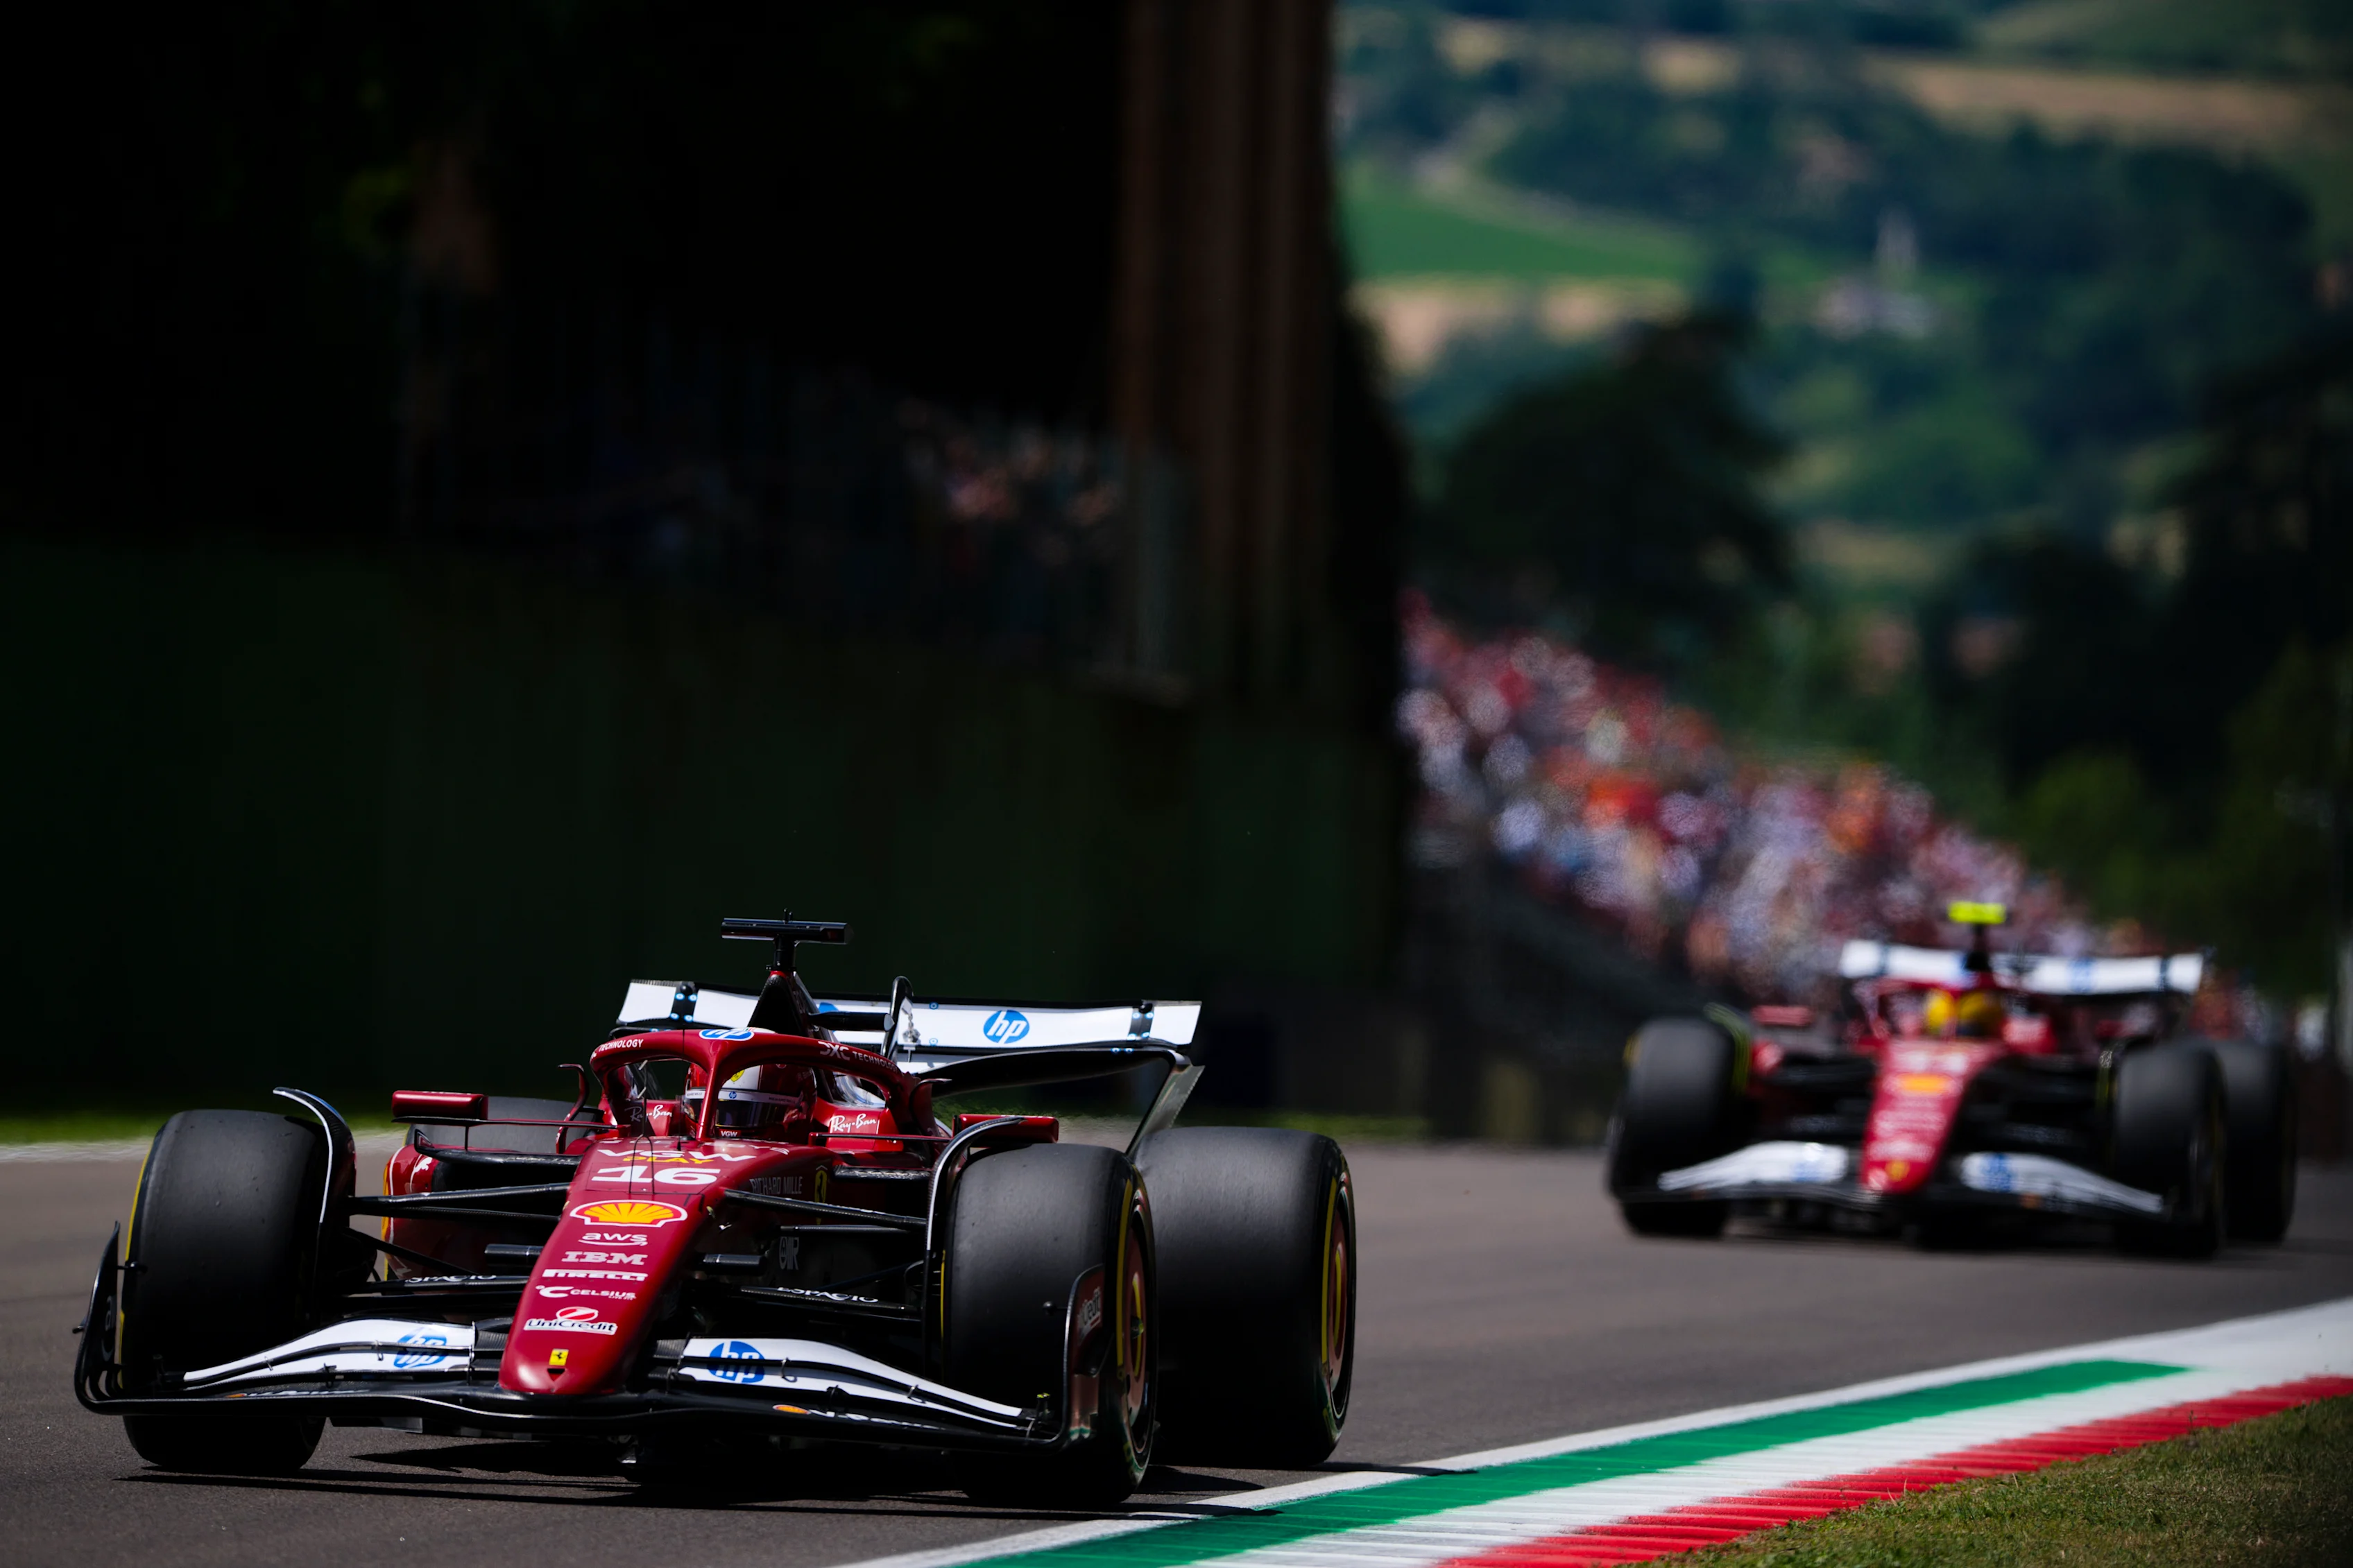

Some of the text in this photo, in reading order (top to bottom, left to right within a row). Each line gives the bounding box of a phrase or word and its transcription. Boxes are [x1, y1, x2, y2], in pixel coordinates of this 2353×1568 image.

[986, 1010, 1027, 1043] hp
[598, 1039, 644, 1052] TECHNOLOGY
[818, 1041, 898, 1074] DXC TECHNOLOGY
[625, 1104, 672, 1122] Ra-Ban
[830, 1113, 877, 1133] Ray-Ban
[597, 1149, 757, 1162] VGW
[623, 1156, 714, 1164] PLAY
[591, 1165, 721, 1185] 16
[749, 1176, 803, 1195] RICHARD MILLE
[581, 1232, 648, 1243] aws
[561, 1251, 649, 1266] IBM
[542, 1269, 649, 1282] PIRELLI
[570, 1289, 636, 1298] CELSIUS
[528, 1318, 616, 1332] UniCredit
